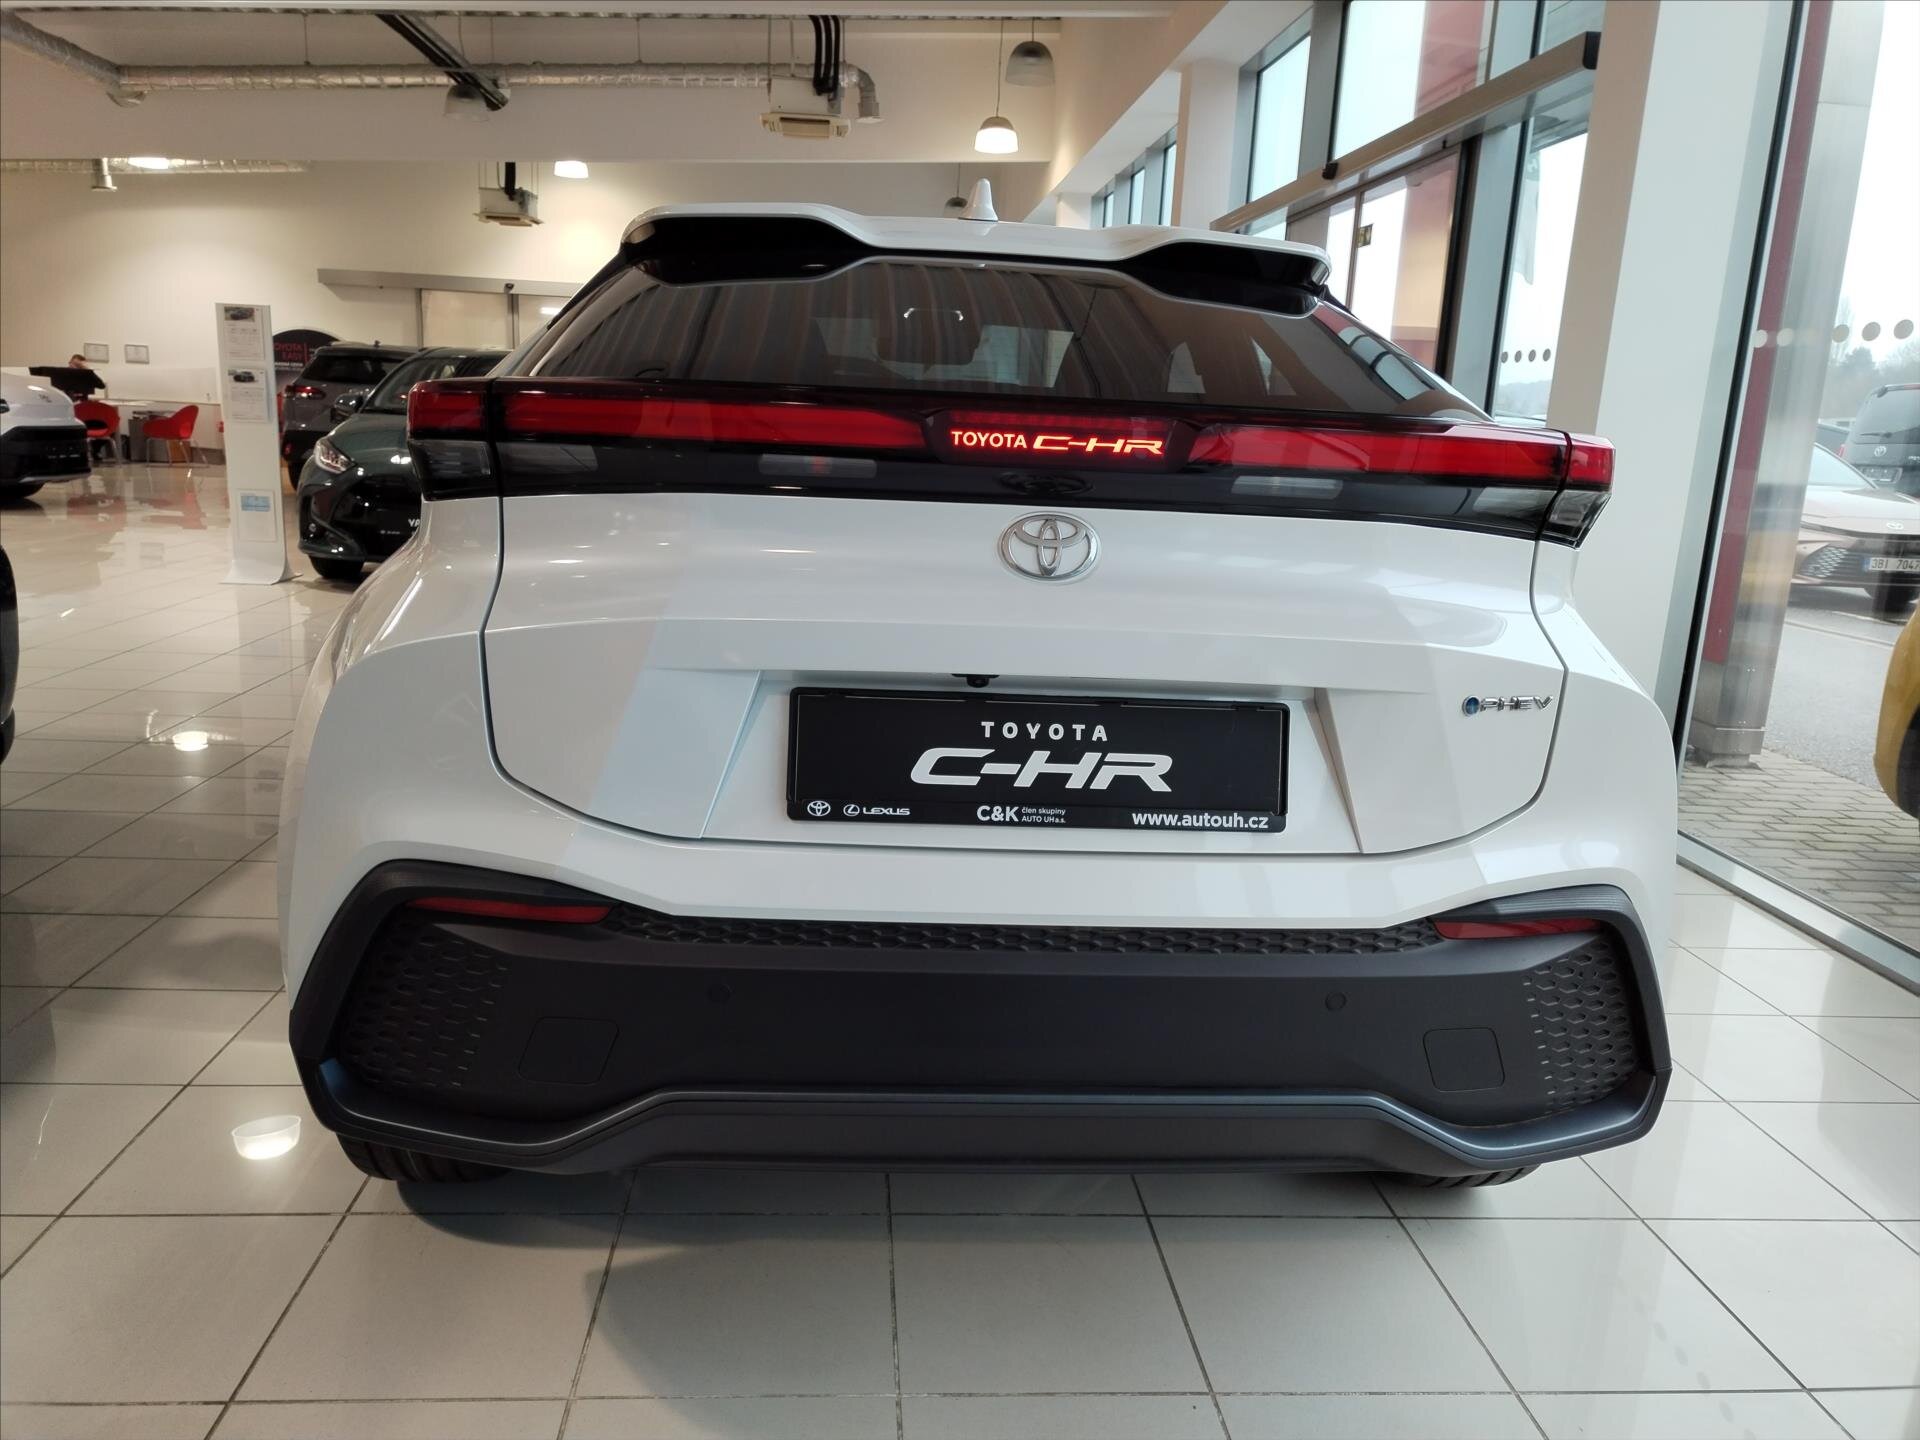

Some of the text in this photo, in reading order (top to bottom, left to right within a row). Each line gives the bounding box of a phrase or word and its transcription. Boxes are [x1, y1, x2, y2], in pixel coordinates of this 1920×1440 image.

[951, 431, 1163, 455] TOYOTA C-HR
[1480, 696, 1554, 711] PHEV
[981, 721, 1108, 742] TOYOTA
[910, 747, 1173, 792] C-HR
[863, 806, 911, 816] LEXUS
[976, 805, 1020, 822] C&K
[1021, 815, 1042, 823] AUTO
[1038, 807, 1066, 815] skupiny
[1132, 812, 1269, 829] www.autouh.cz
